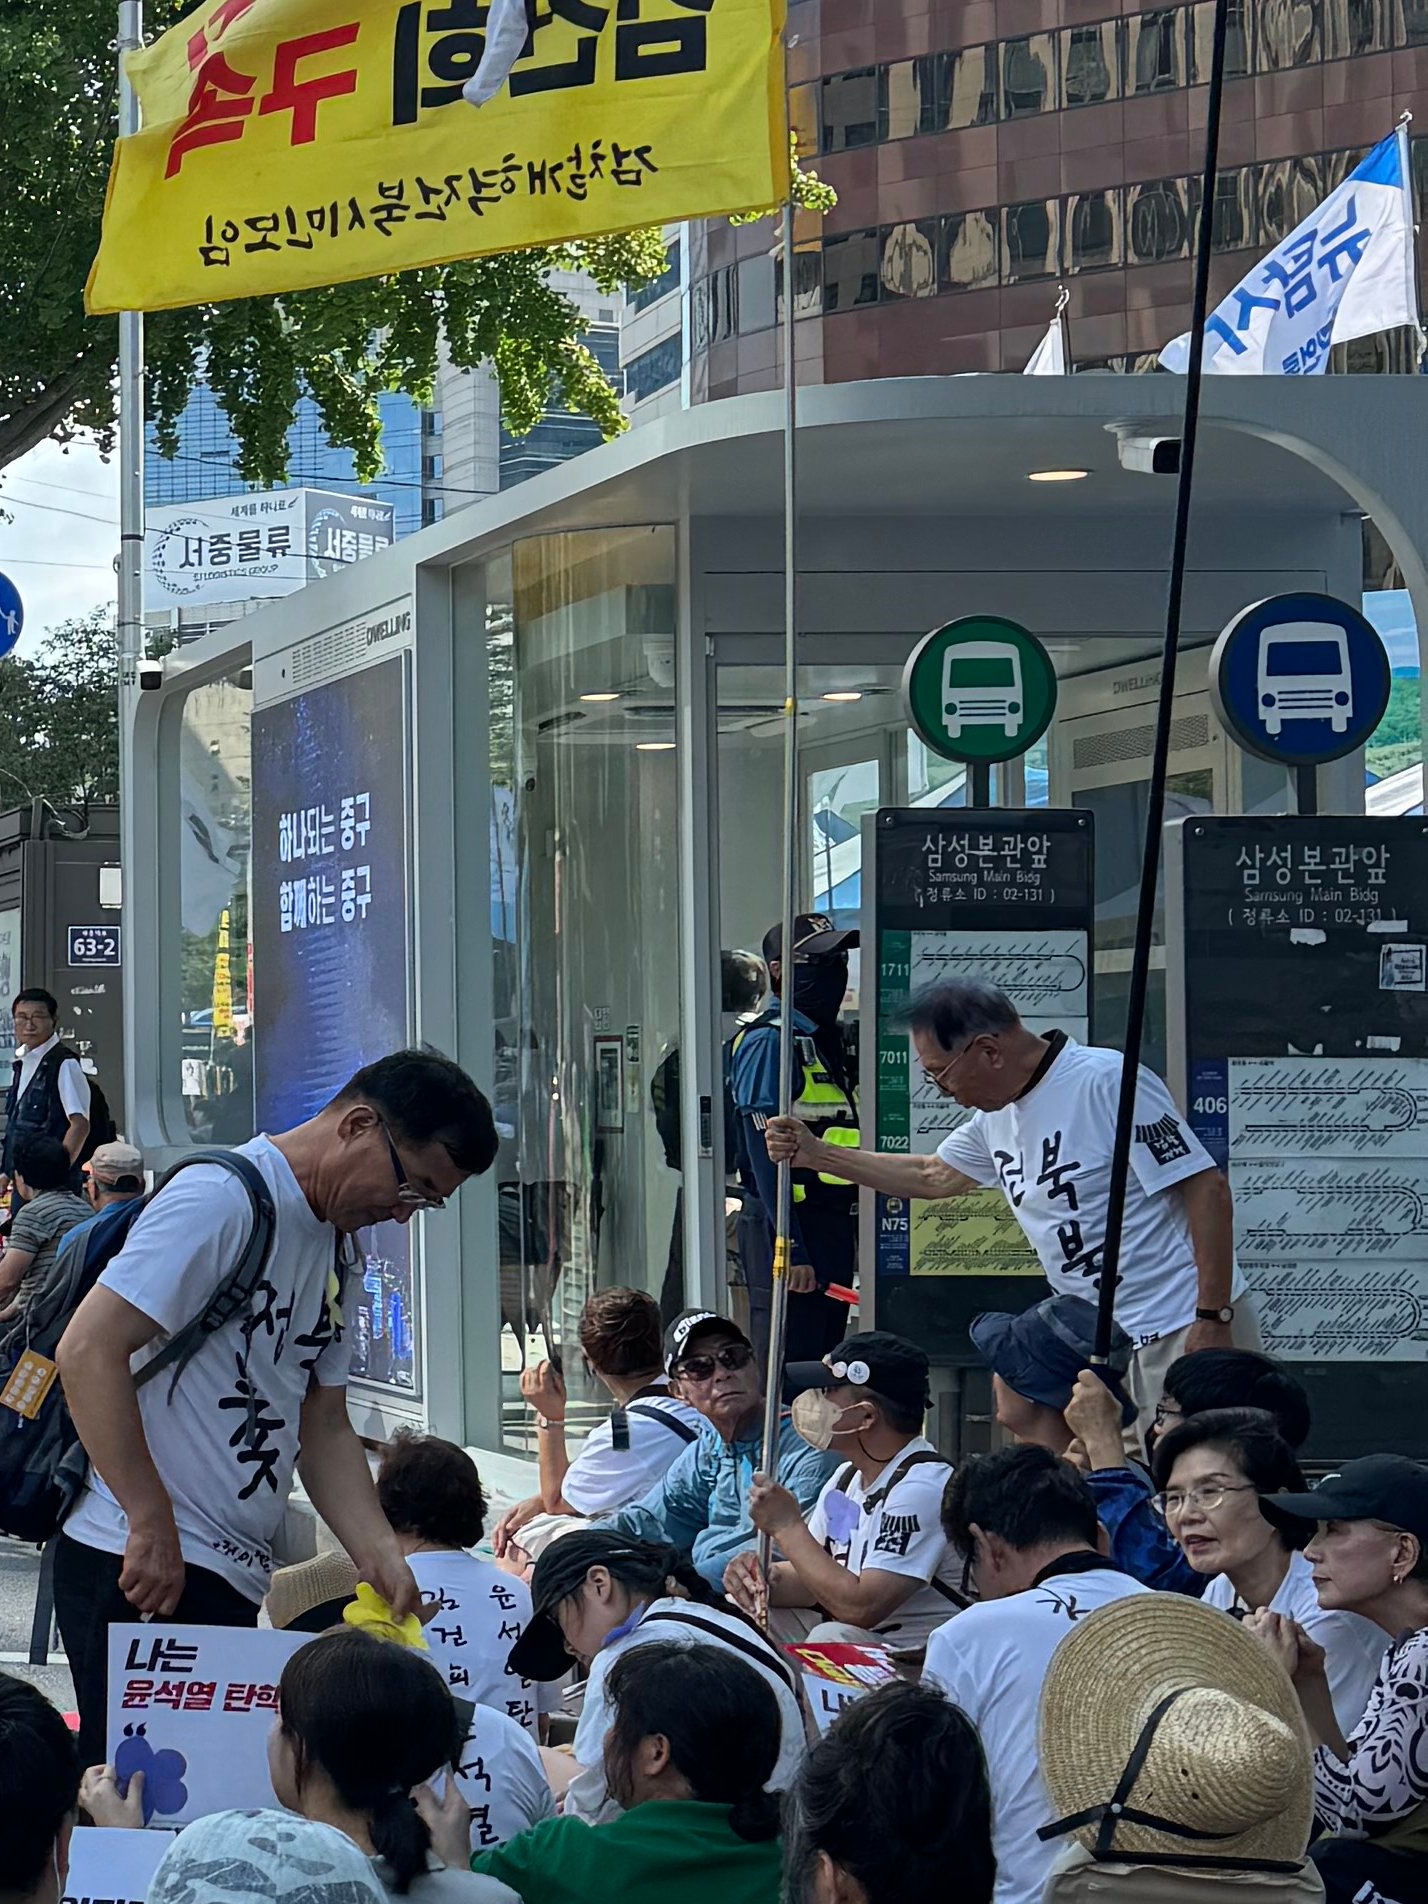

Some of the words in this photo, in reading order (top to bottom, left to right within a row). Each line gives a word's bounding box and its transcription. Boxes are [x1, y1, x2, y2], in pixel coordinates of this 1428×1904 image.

[179, 525, 291, 569] 서중물류
[366, 612, 411, 646] DWELLING
[279, 804, 335, 863] 하나되는
[340, 792, 370, 850] 중구
[922, 833, 1051, 868] 삼성본관앞
[929, 870, 977, 885] Samsung
[984, 871, 1010, 883] Main
[1236, 844, 1390, 885] 삼성본관앞
[279, 875, 336, 932] 함께하는
[342, 865, 371, 922] 중구
[926, 887, 967, 903] 정류소
[974, 889, 986, 900] ID
[1003, 889, 1043, 901] 02-131
[1245, 888, 1303, 904] Samsung
[1311, 887, 1342, 901] Main
[1243, 908, 1290, 925] 정류소
[1299, 909, 1314, 922] ID
[1335, 908, 1381, 924] 02-131
[74, 938, 115, 956] 63-2
[881, 963, 910, 977] 1711
[880, 1051, 908, 1064] 7011
[1194, 1096, 1227, 1114] 406
[880, 1134, 909, 1149] 7022
[882, 1217, 908, 1231] N75
[1057, 1219, 1124, 1289] 불
[218, 1379, 286, 1500] 촛
[126, 1636, 199, 1673] 나는
[121, 1679, 217, 1713] 윤석열
